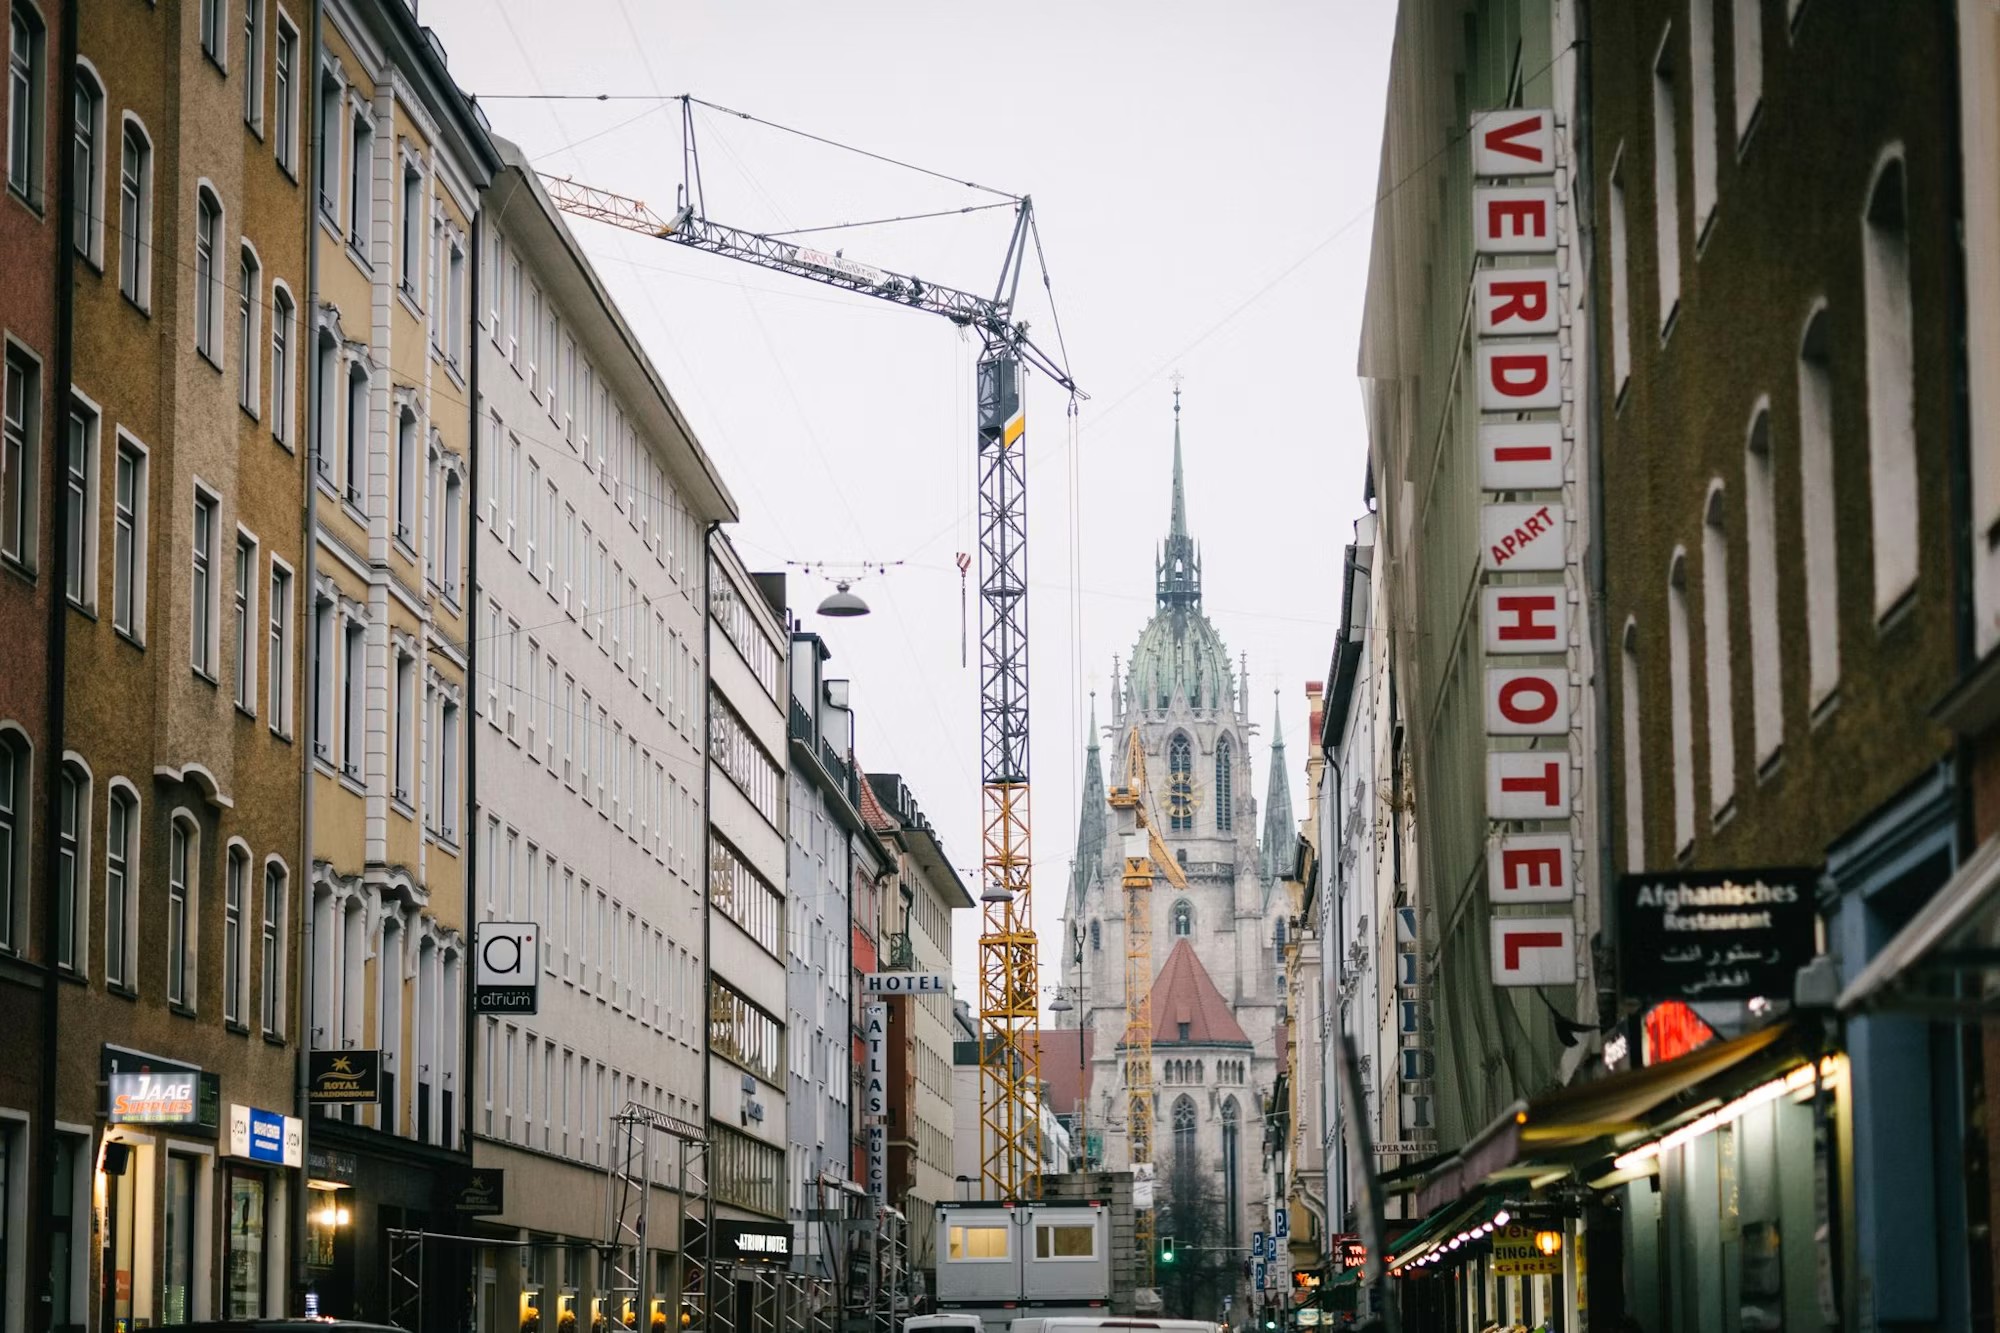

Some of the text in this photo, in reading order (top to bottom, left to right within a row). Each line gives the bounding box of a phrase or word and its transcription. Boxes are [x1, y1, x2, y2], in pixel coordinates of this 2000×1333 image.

[1485, 115, 1552, 462] VERDI
[1491, 506, 1555, 567] APART
[1497, 596, 1563, 970] HOTEL
[1637, 880, 1799, 912] Afghanisches
[1663, 911, 1772, 931] Restaurant
[869, 975, 944, 991] HOTEL
[480, 992, 531, 1006] atrium
[869, 1019, 883, 1112] ATLAS
[131, 1076, 191, 1101] JAAG
[311, 1090, 376, 1098] OARDINGHOUSE
[323, 1081, 360, 1090] ROYAL
[869, 1128, 883, 1212] MÜNCHE
[1276, 1211, 1283, 1235] P
[734, 1233, 766, 1252] ATRIUM
[766, 1235, 788, 1254] HOTEL
[1254, 1234, 1261, 1253] P
[1268, 1240, 1275, 1259] P
[1256, 1266, 1263, 1286] P
